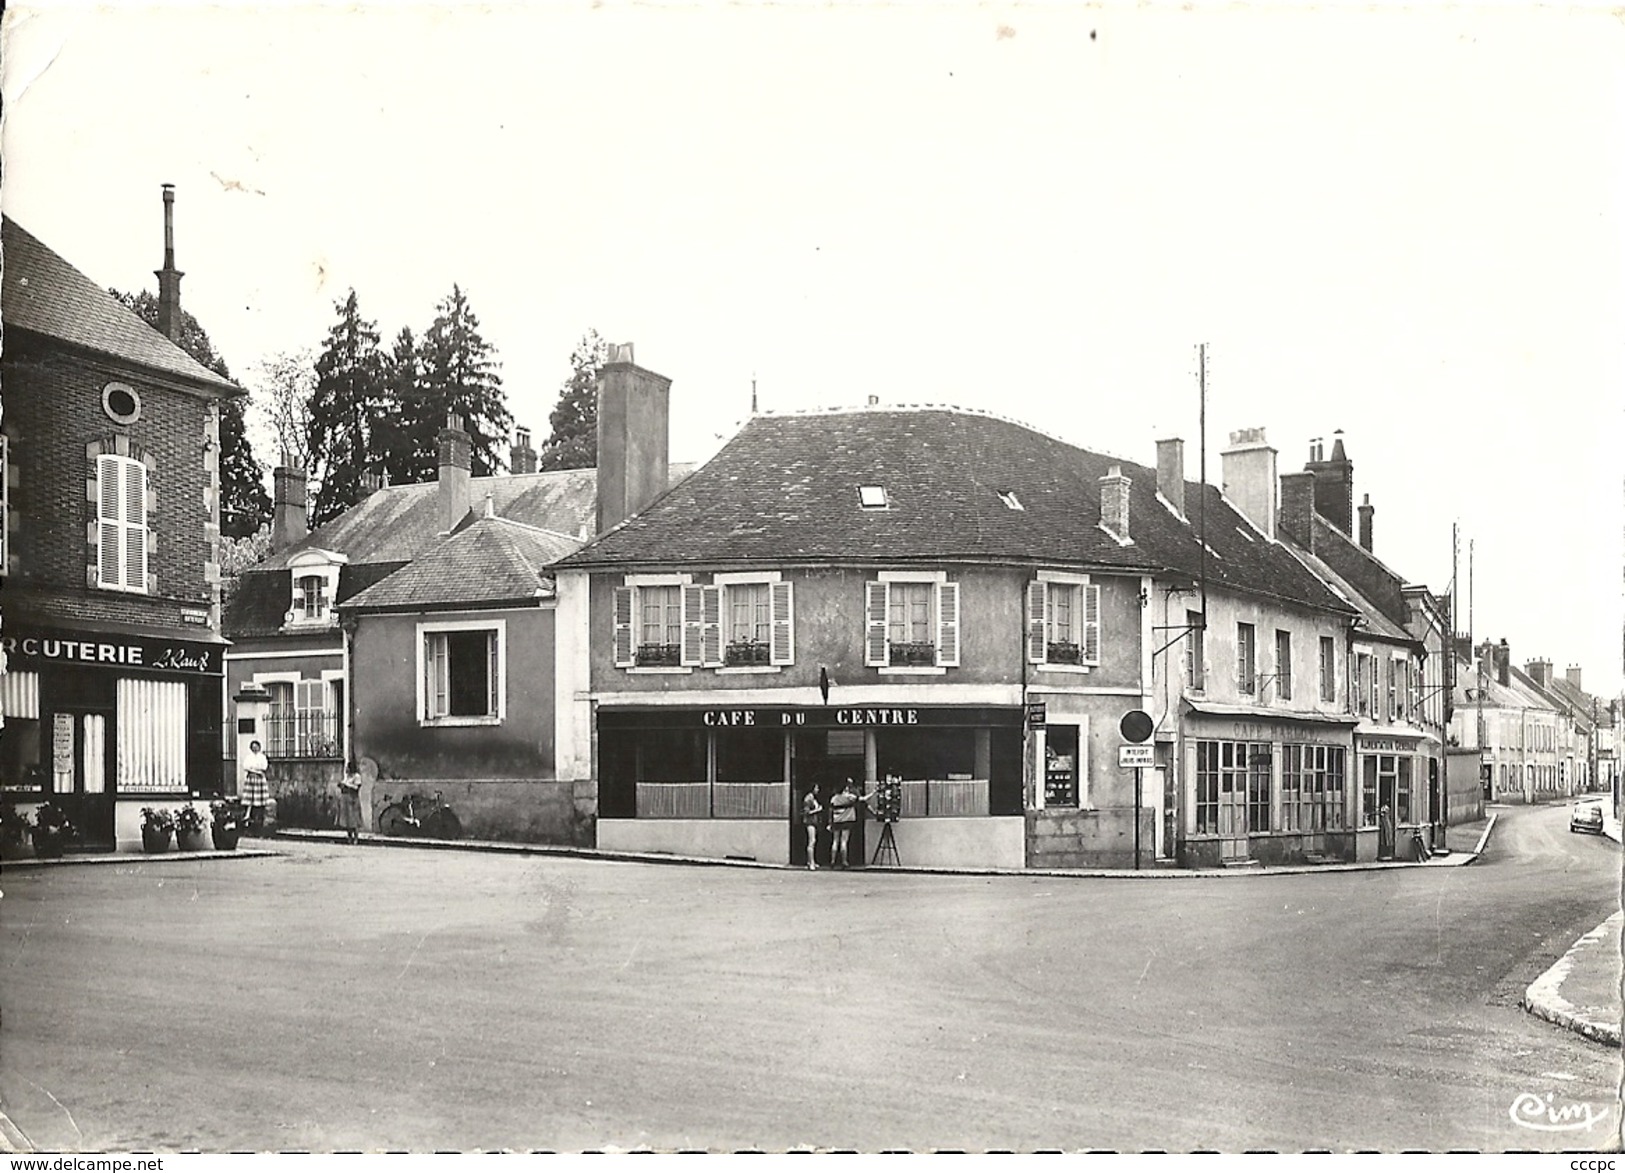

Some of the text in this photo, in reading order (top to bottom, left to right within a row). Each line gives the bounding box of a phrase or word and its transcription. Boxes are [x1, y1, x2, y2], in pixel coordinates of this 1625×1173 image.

[703, 709, 918, 726] CAFE DU CENTRE
